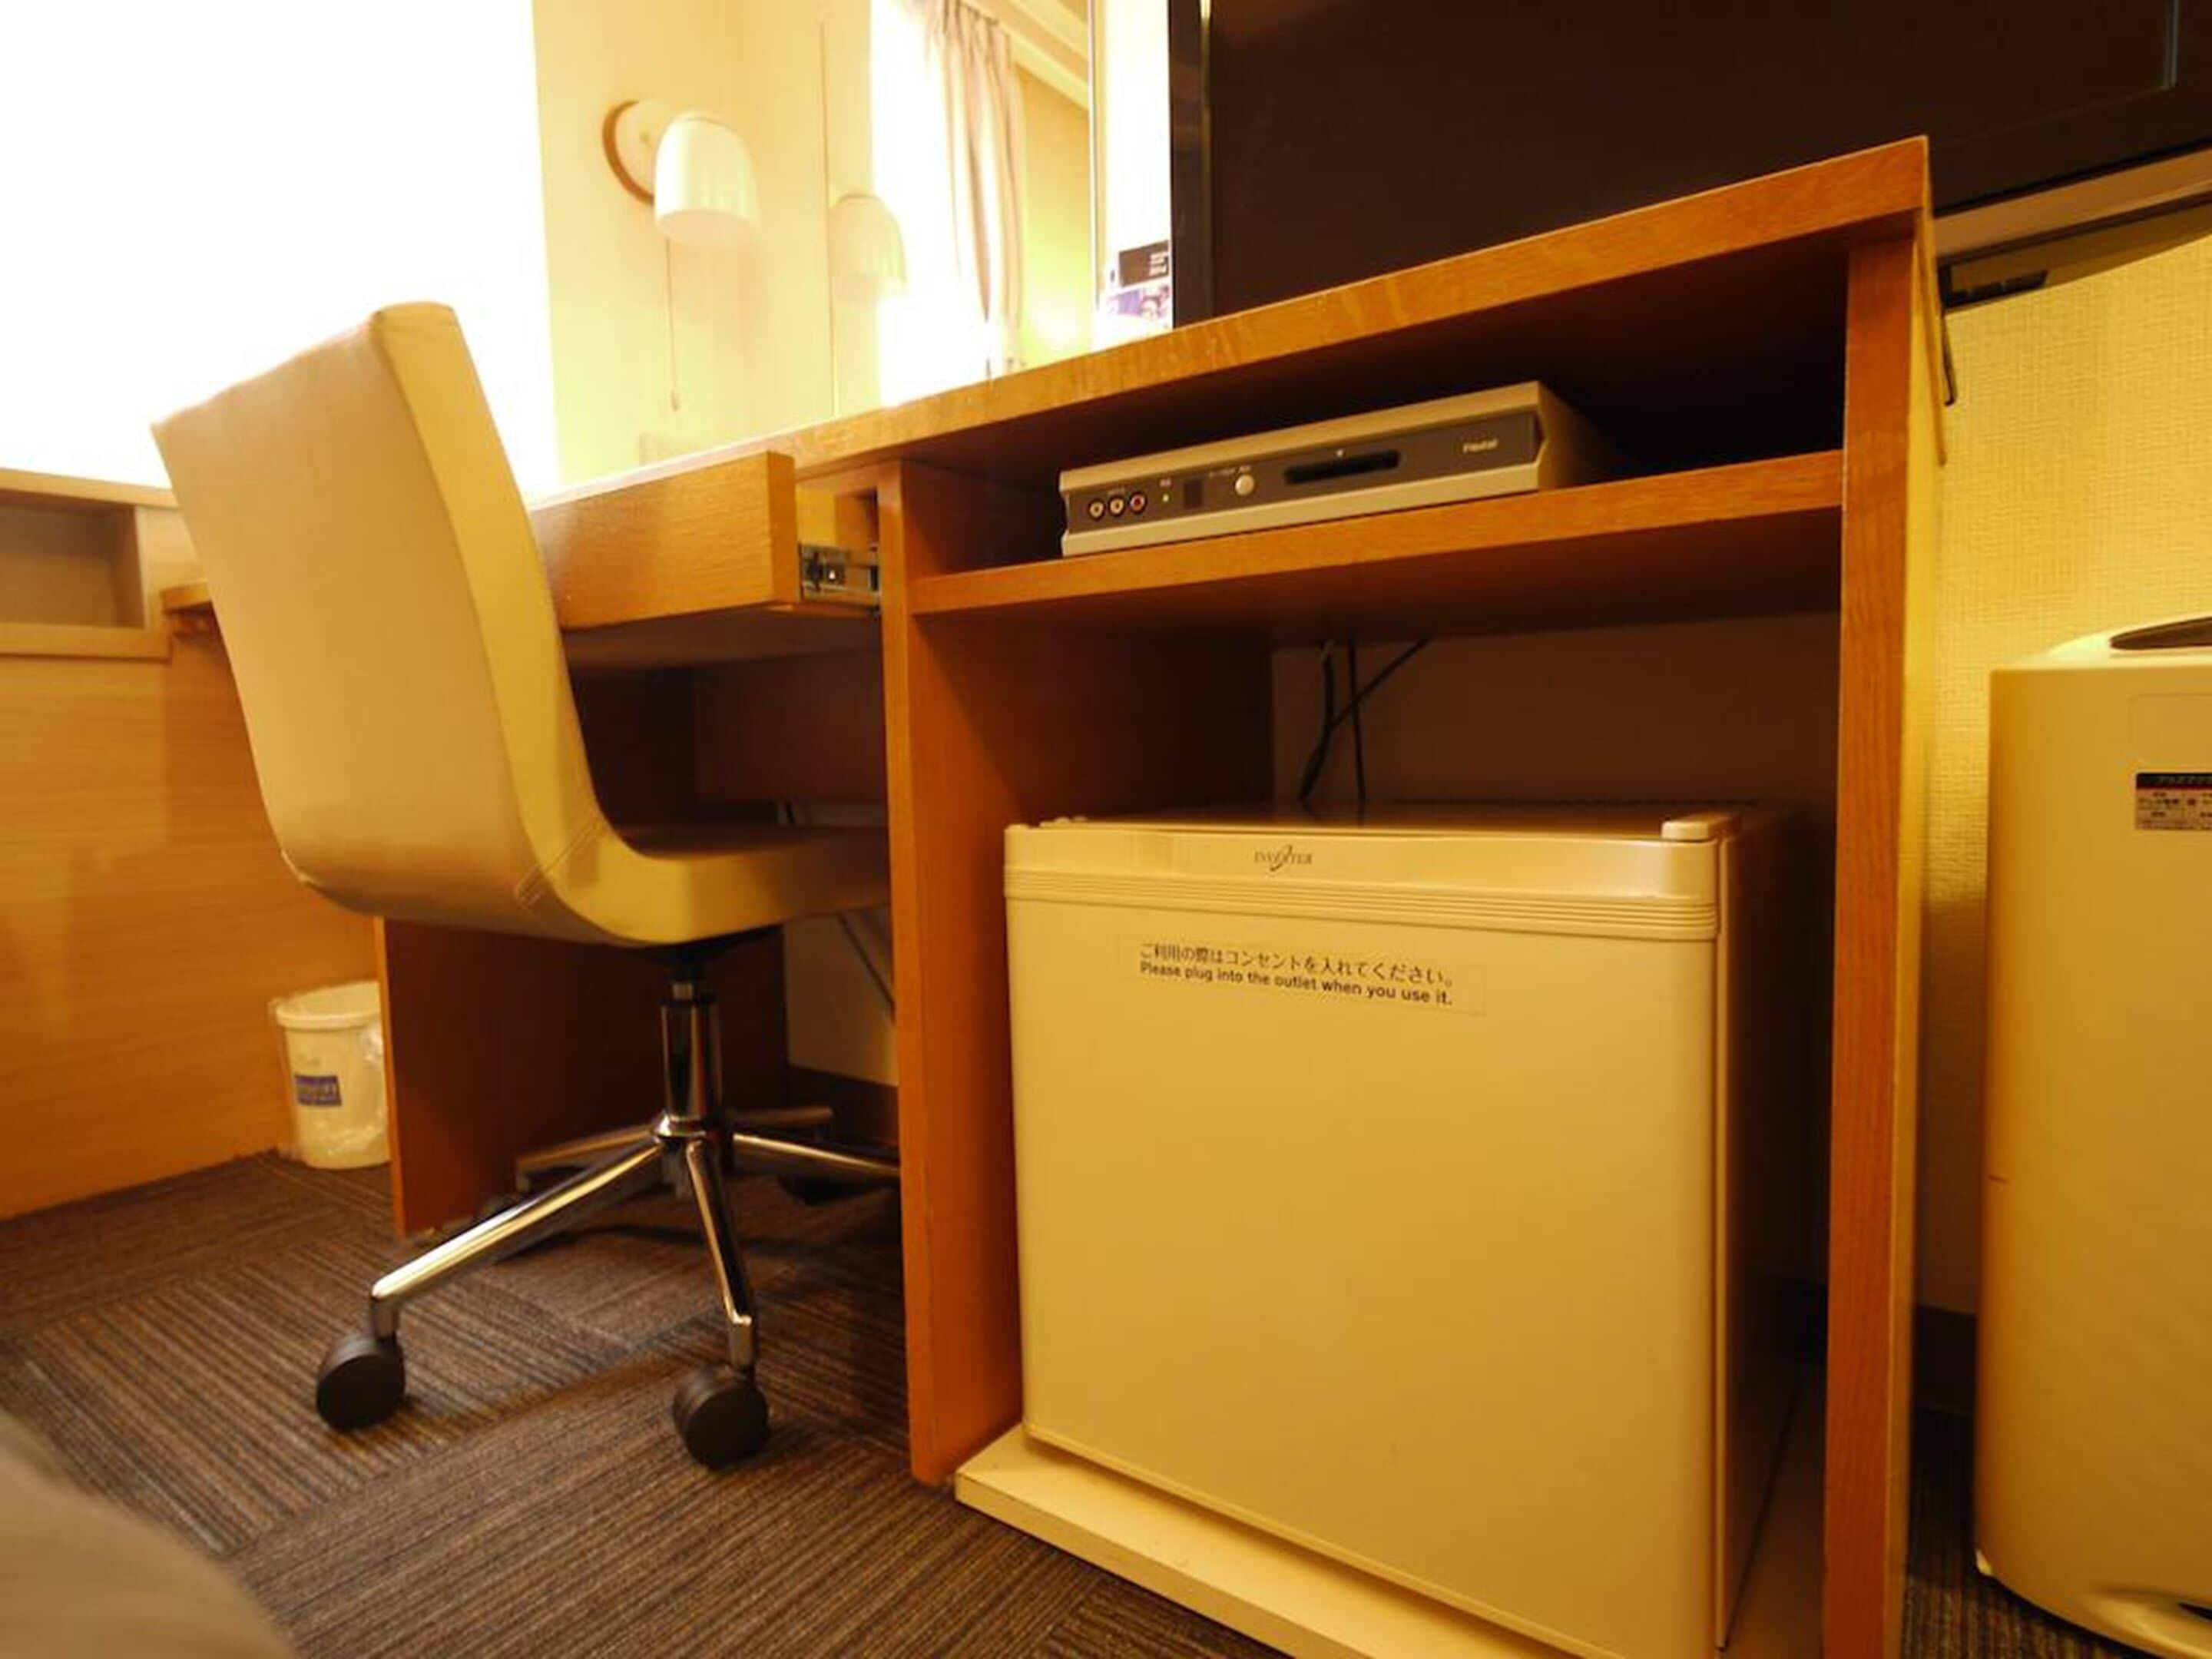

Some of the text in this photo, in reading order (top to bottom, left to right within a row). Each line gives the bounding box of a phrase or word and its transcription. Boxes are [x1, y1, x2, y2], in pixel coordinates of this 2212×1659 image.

[1140, 960, 1453, 1005] Please plug into the outlet when you use it.
